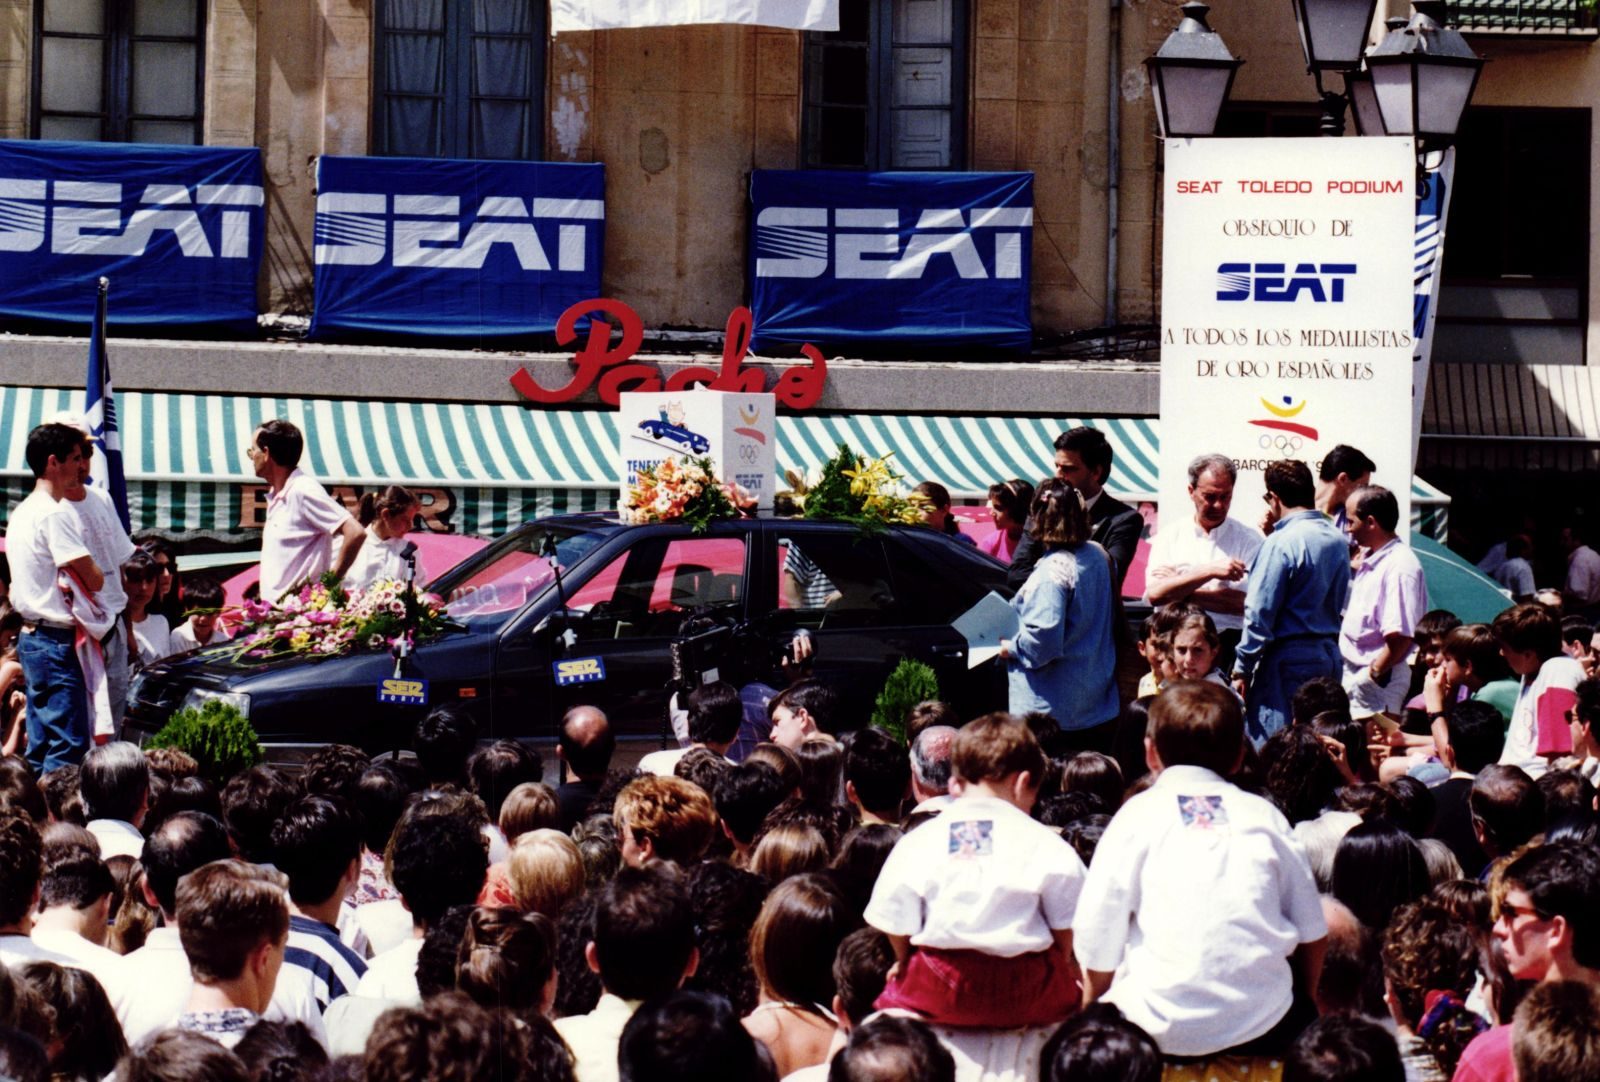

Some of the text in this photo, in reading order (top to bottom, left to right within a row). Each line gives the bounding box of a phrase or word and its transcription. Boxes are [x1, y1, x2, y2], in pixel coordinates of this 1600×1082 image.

[1177, 180, 1403, 194] SEAT TOLEDO PODIUM
[314, 192, 605, 272] SEAT
[1222, 219, 1353, 239] OBSEQUIO DE
[756, 206, 1034, 280] SEAT
[1216, 263, 1358, 303] SEAT
[1164, 328, 1411, 348] A TODOS LOS MEDALLISTAS
[1197, 359, 1374, 380] DE ORO ESPAÑOLES
